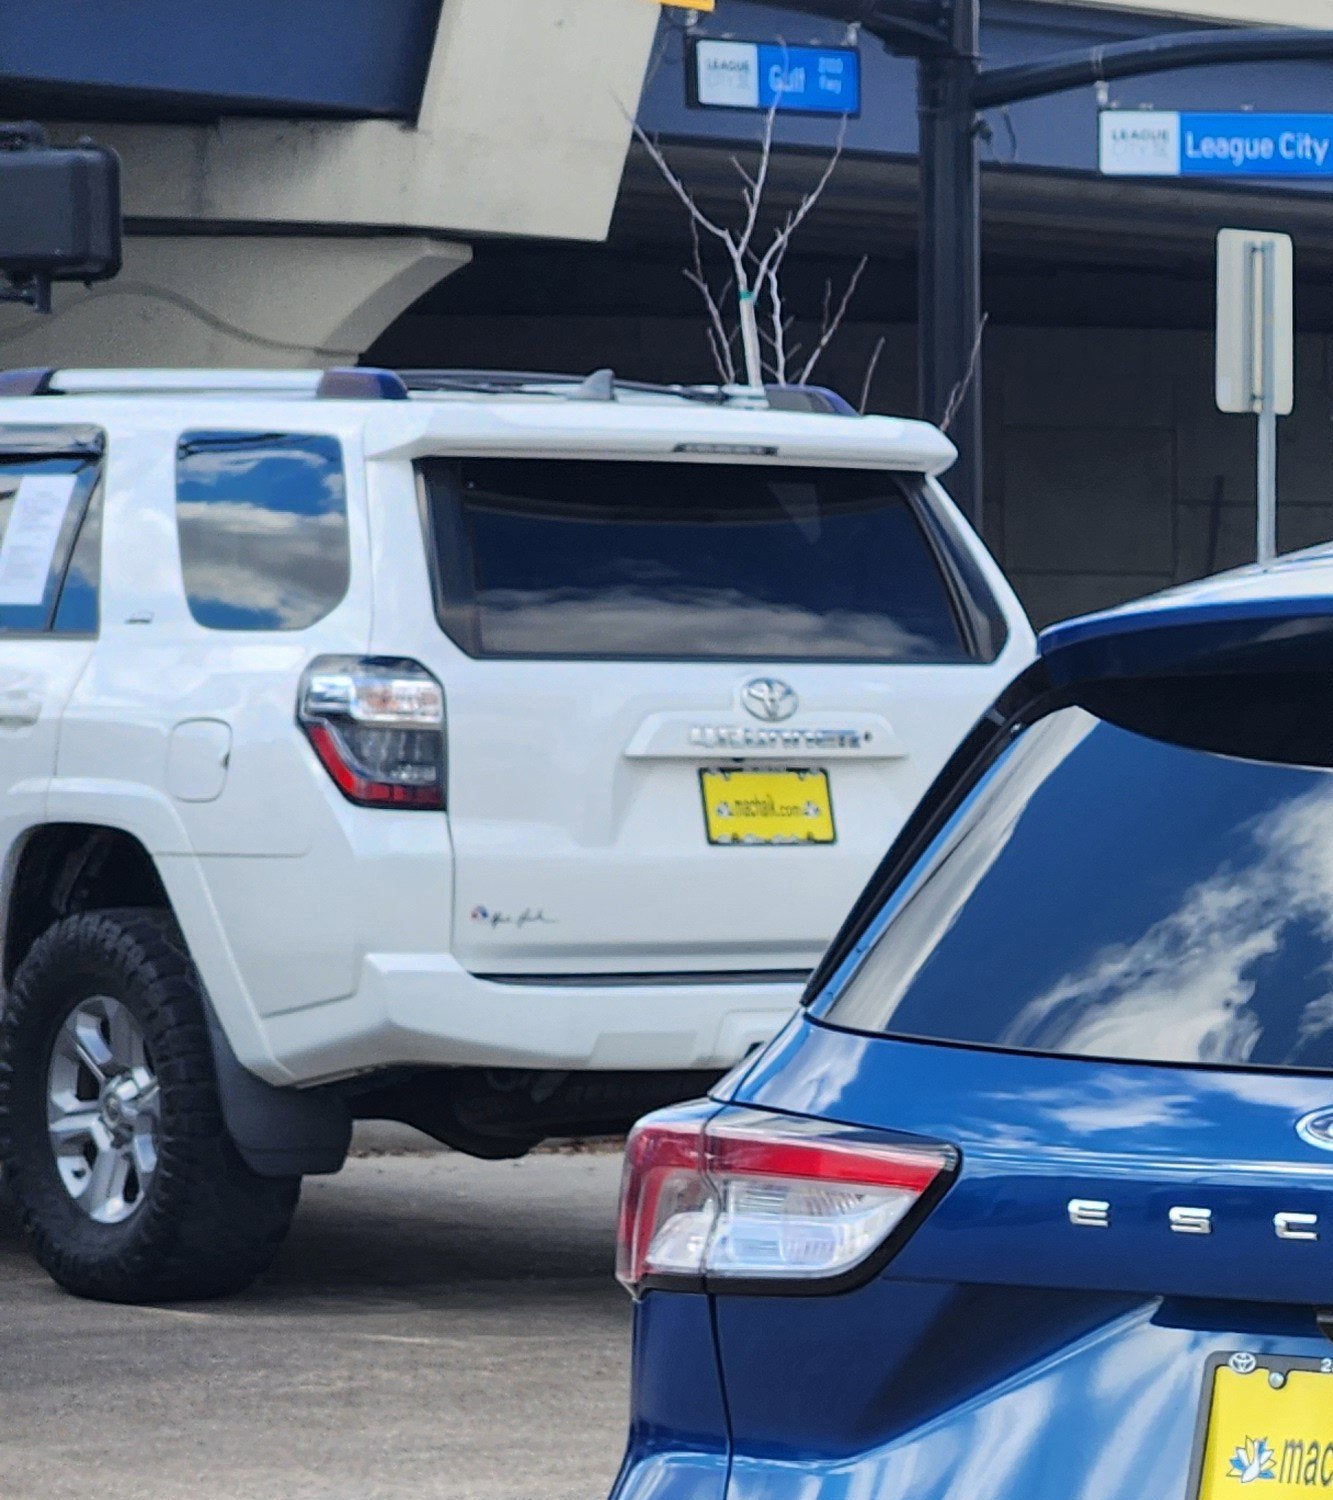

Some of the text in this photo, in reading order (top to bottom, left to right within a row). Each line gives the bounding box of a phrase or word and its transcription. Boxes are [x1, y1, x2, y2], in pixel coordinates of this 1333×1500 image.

[768, 64, 805, 94] Gulf
[1185, 131, 1330, 167] League City
